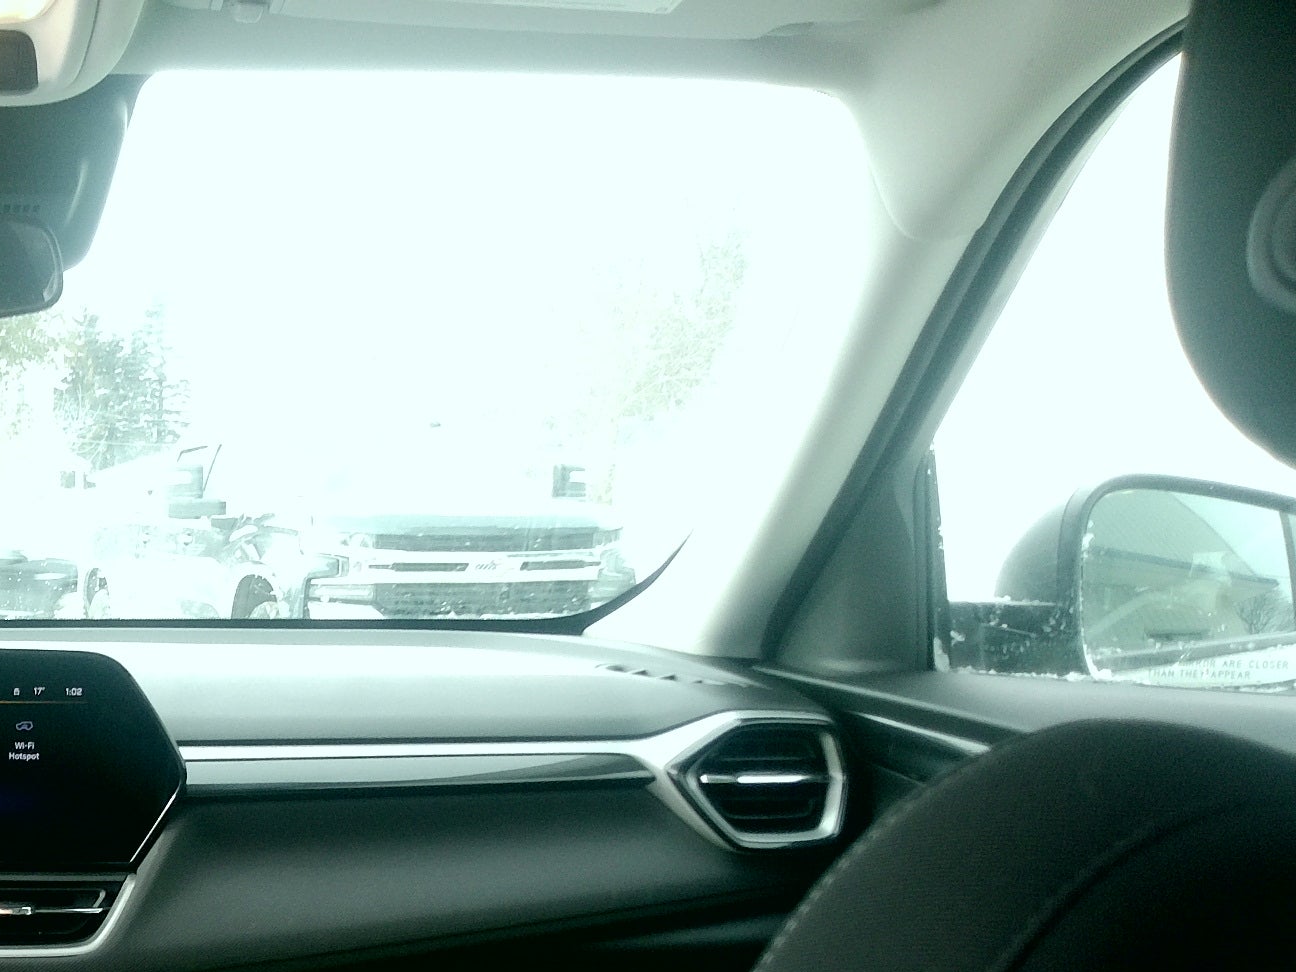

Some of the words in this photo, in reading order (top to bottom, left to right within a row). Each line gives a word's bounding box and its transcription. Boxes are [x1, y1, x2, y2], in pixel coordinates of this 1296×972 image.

[1222, 659, 1243, 669] ARE
[1248, 660, 1289, 670] CLOSER
[1210, 670, 1251, 679] APPEAR
[65, 687, 83, 697] 1:02
[14, 741, 35, 750] Wi-Fi
[8, 752, 40, 762] Hotspot
